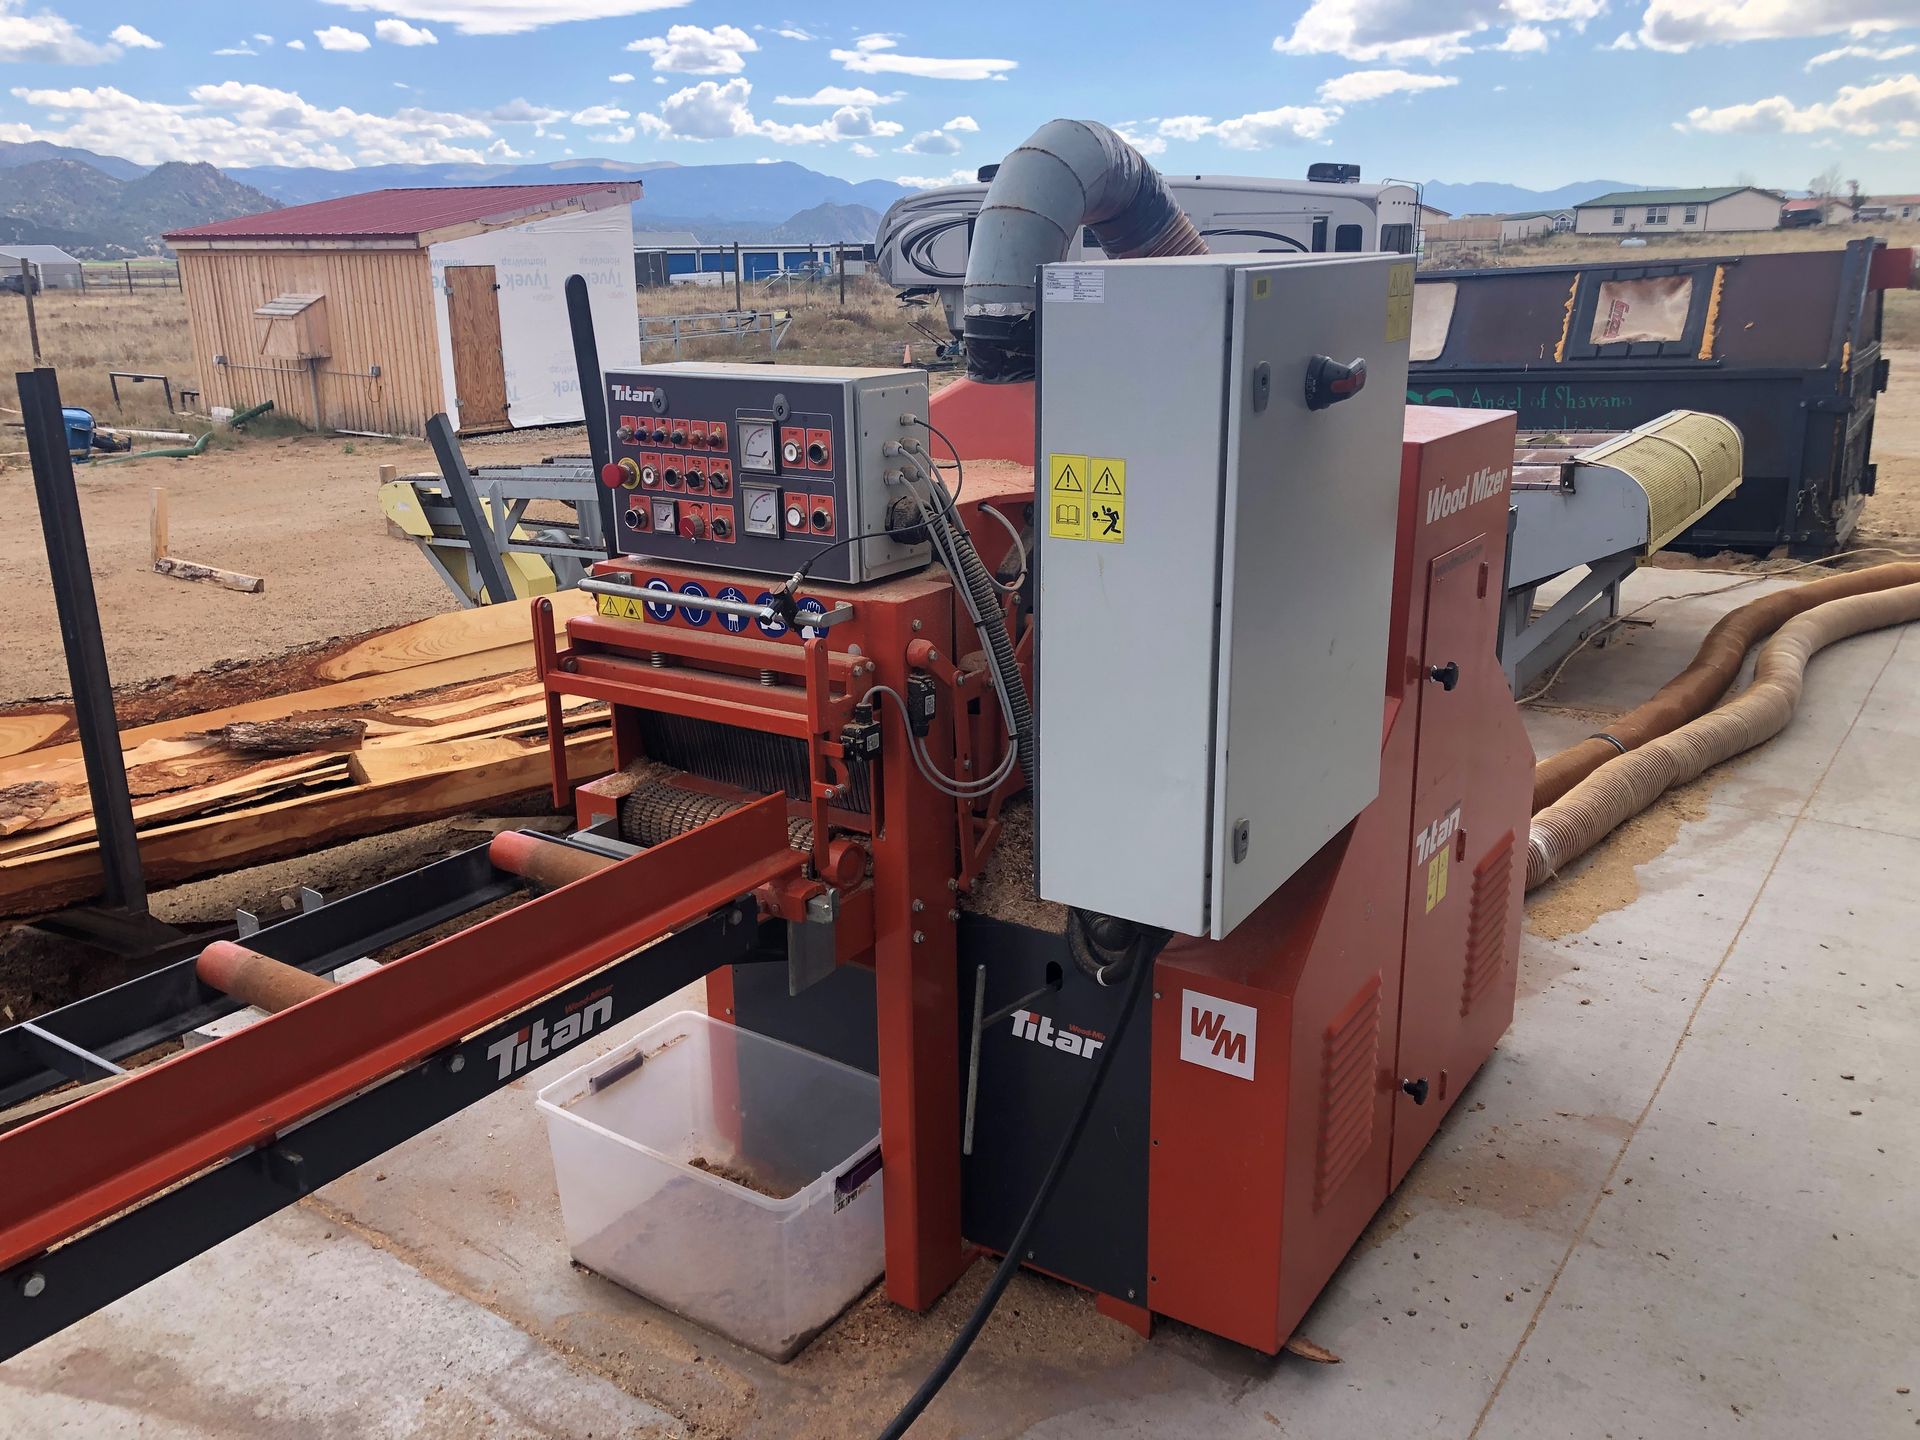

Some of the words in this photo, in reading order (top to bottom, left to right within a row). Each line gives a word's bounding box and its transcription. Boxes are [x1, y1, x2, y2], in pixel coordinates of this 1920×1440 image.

[504, 270, 552, 290] Tyvek
[611, 384, 655, 403] Titan
[1426, 476, 1470, 525] Wood
[1470, 467, 1508, 505] Mizer
[1415, 808, 1460, 867] Titan
[486, 994, 613, 1081] Titan
[1190, 1006, 1248, 1064] WM
